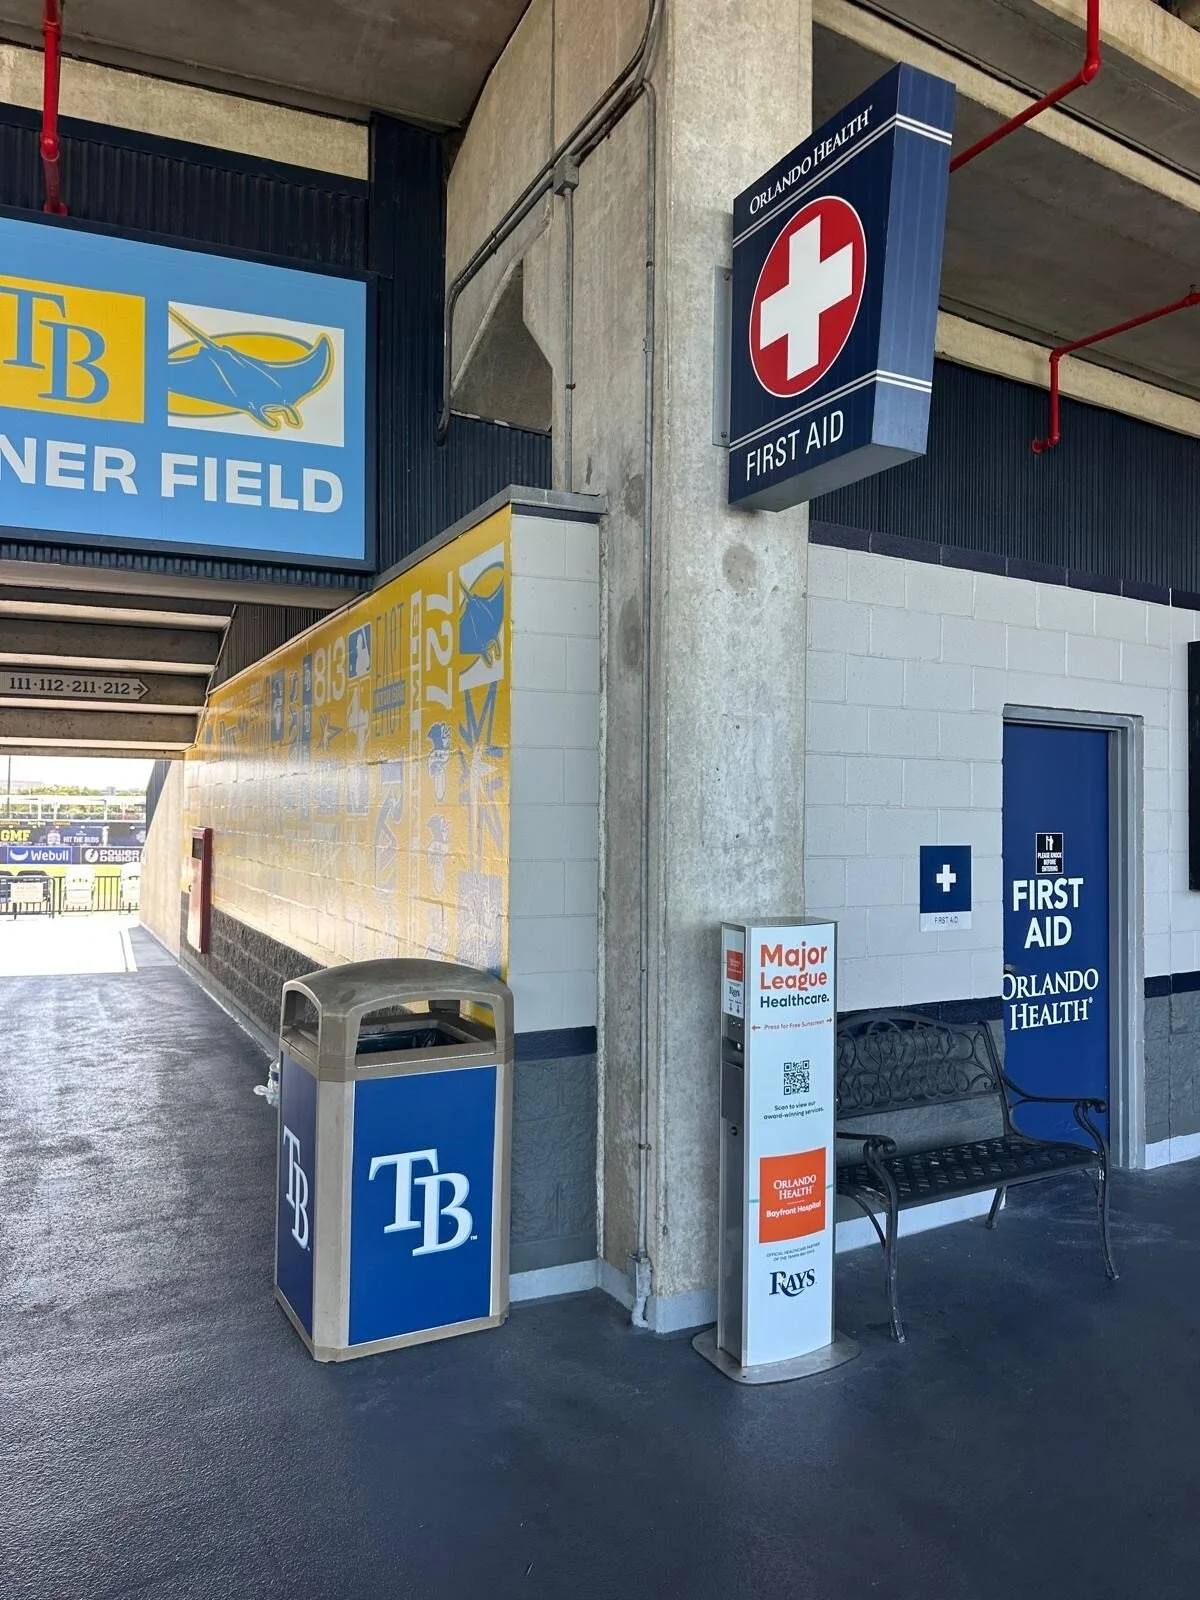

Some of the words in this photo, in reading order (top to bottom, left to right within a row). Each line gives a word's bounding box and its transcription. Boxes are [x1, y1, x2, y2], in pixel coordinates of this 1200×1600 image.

[749, 156, 812, 215] ORLANDO
[813, 108, 870, 167] HEALTH
[0, 284, 111, 404] TB
[746, 429, 800, 482] FIRST
[805, 410, 844, 455] AID
[0, 434, 138, 495] NER
[161, 452, 344, 514] FIELD
[426, 571, 454, 709] 727
[314, 636, 346, 707] 813
[0, 829, 31, 842] GMF
[30, 850, 69, 861] Webull
[1013, 878, 1084, 912] FIRST
[1024, 915, 1073, 949] AID
[760, 940, 828, 972] Major
[760, 971, 828, 991] League
[1002, 968, 1099, 1001] ORLANDO
[760, 993, 830, 1008] Healthcare.
[1010, 999, 1090, 1031] HEALTH
[801, 1019, 825, 1028] Sunscreen
[283, 1125, 309, 1251] TB
[773, 1174, 817, 1191] ORLANDO
[778, 1186, 813, 1201] HEALTH
[368, 1148, 474, 1257] TB
[766, 1204, 797, 1218] Bayfront
[797, 1199, 822, 1213] Hospital
[769, 1268, 816, 1298] RAYS
